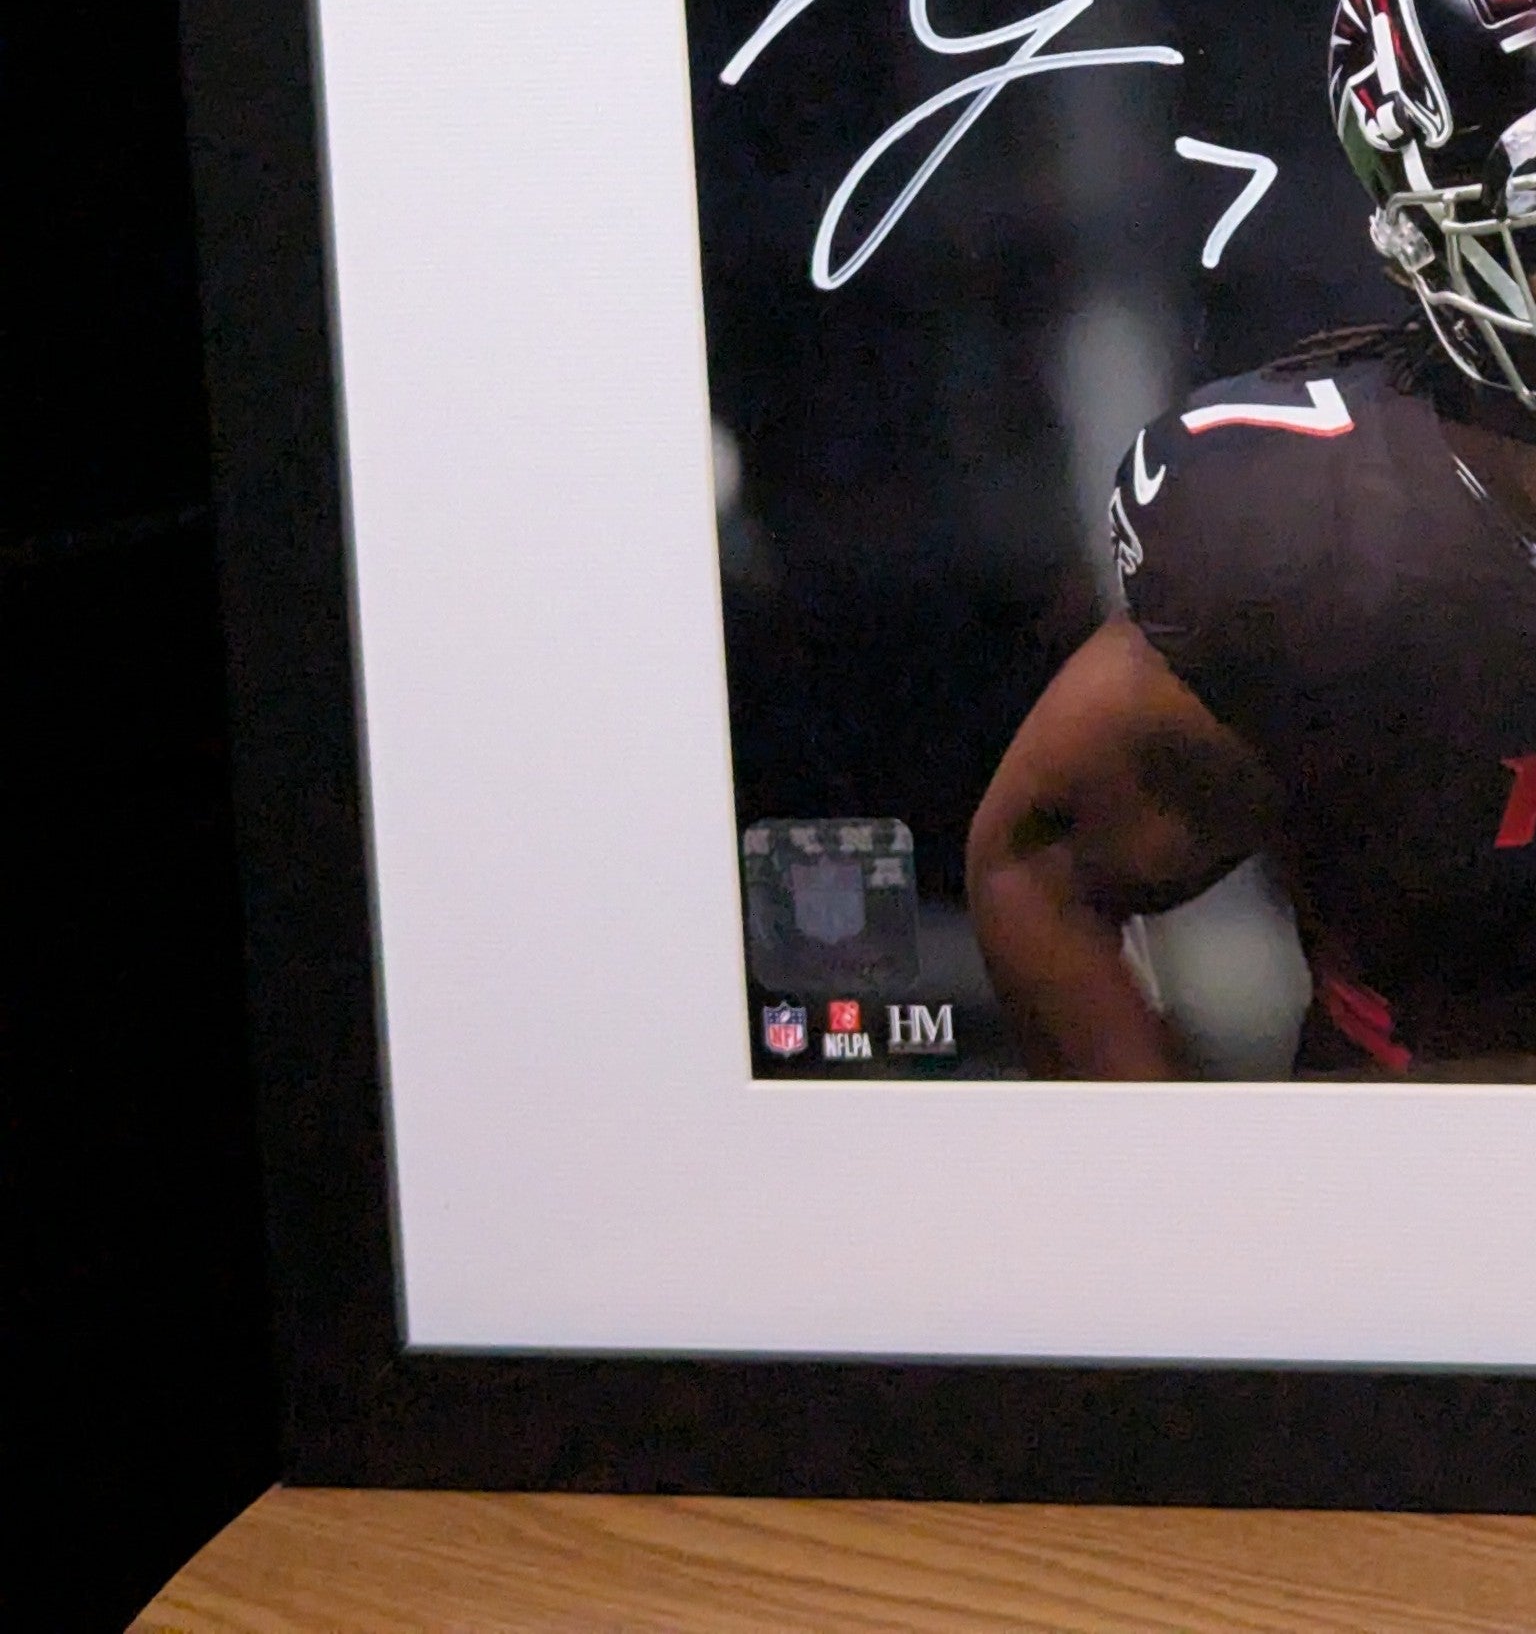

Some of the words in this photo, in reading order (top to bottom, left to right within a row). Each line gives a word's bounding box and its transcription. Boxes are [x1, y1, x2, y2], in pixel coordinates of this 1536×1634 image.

[1175, 135, 1278, 269] 7
[1180, 378, 1355, 438] 7
[768, 1024, 804, 1051] NFL
[885, 1004, 954, 1043] HM
[823, 1032, 873, 1058] NFLPA
